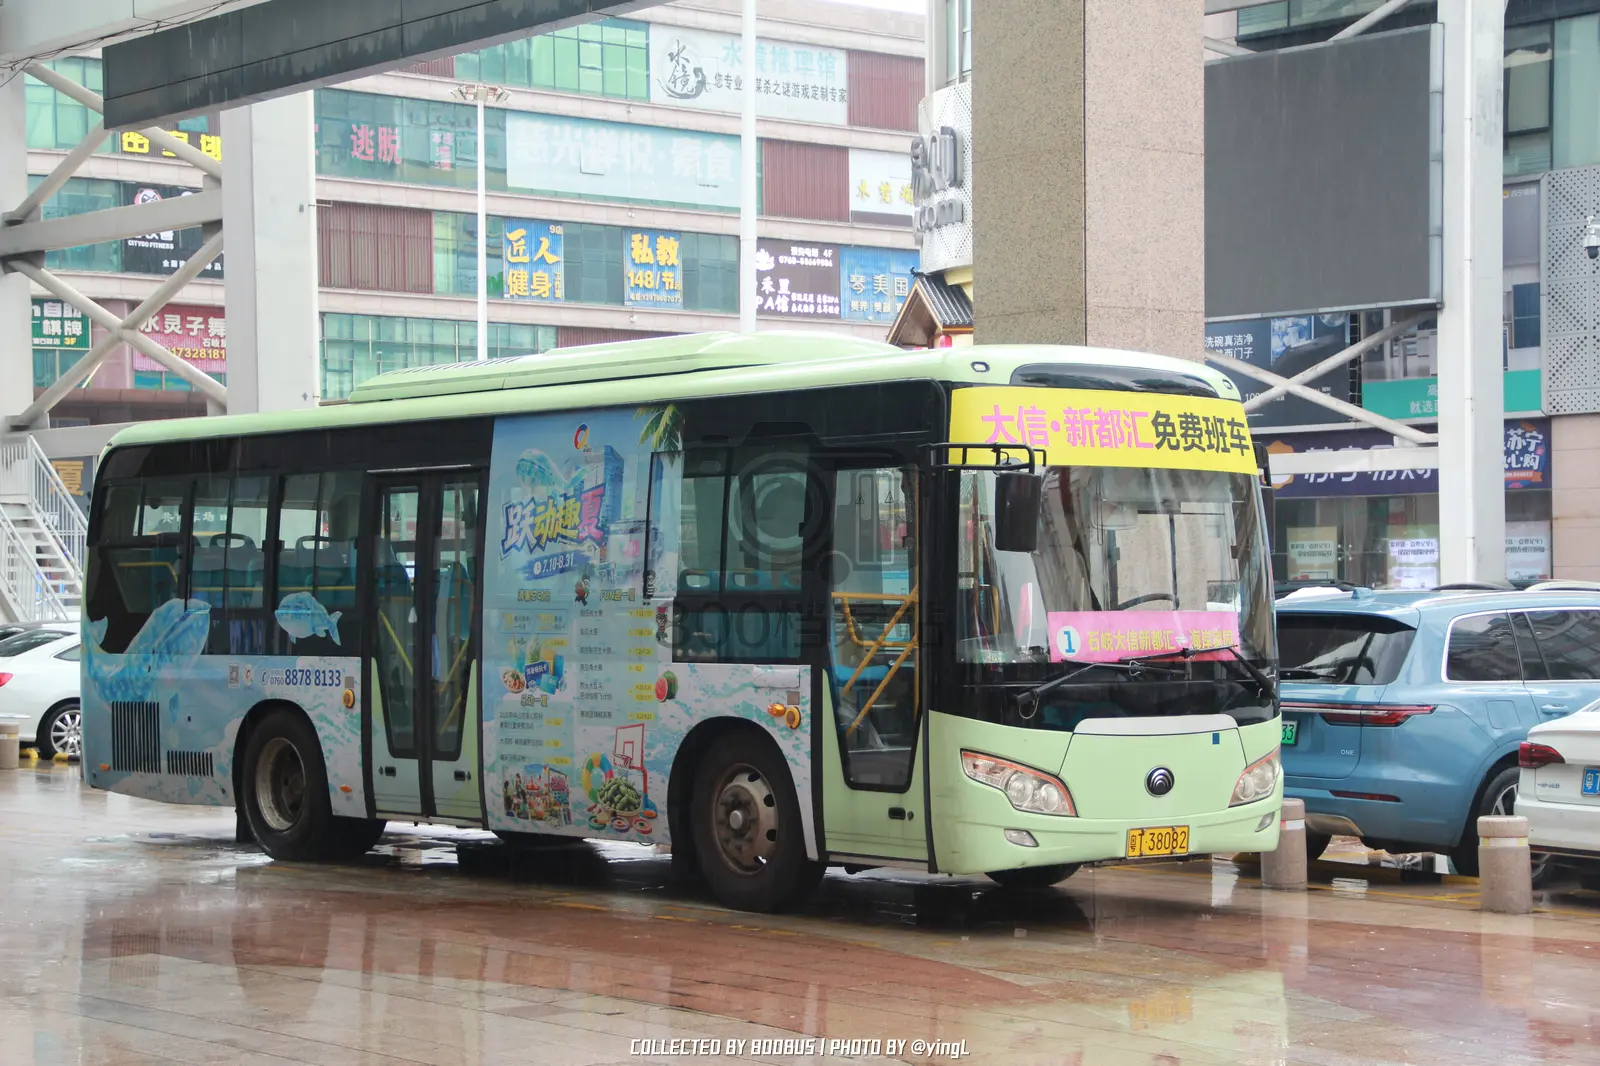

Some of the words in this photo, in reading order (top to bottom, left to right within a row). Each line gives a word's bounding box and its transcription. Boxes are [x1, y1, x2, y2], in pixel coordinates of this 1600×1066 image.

[714, 72, 847, 104] 您专业谋杀之谜游戏定制专家
[506, 228, 561, 264] 匠人
[630, 233, 680, 267] 私教
[823, 249, 833, 258] 4F
[507, 269, 552, 298] 健身
[756, 276, 791, 295] 禾里
[64, 336, 76, 346] 3F
[1204, 333, 1254, 348] 洗碗真洁净
[1504, 428, 1543, 452] 苏宁
[1064, 629, 1075, 653] 1
[285, 669, 311, 686] 8878
[314, 670, 341, 687] 8133
[1340, 748, 1354, 756] ONE
